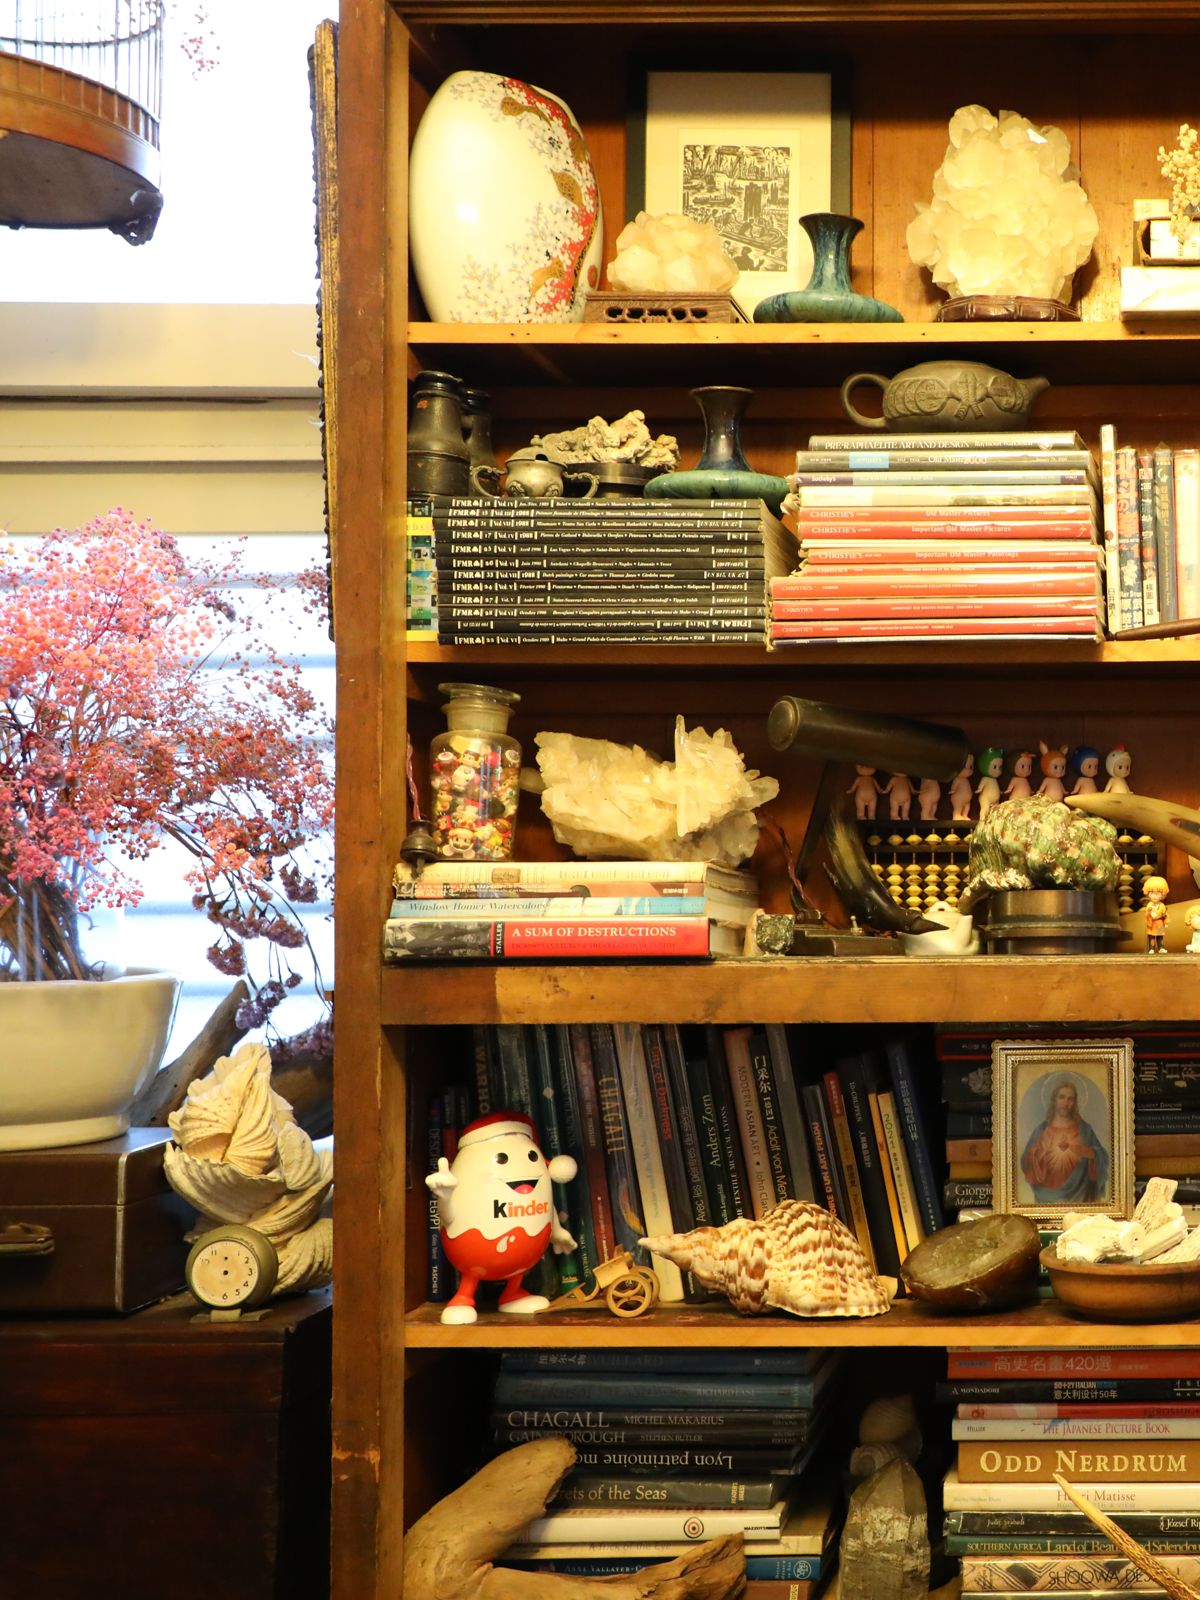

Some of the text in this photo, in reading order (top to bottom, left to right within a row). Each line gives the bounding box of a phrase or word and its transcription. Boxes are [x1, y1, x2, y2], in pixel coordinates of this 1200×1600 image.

[898, 440, 914, 450] ART
[915, 440, 936, 449] AND
[937, 440, 970, 448] DESIGN
[810, 510, 855, 518] CHRISTIE'S
[812, 524, 1011, 534] CHRISTIE'S Important Old Master Pictures
[916, 551, 948, 559] Important
[987, 550, 1018, 559] Paintings
[496, 923, 504, 955] STALLER
[512, 926, 676, 938] A SUM OF DESTRUCTIONS
[598, 1075, 625, 1156] CHAGALL
[658, 1087, 672, 1140] Darkness
[754, 1056, 784, 1170] 门采尔 Adolf von
[702, 1094, 721, 1168] Anders Zorn
[737, 1066, 765, 1192] MODERN ASIAN ART John
[884, 1114, 895, 1149] 2021
[724, 1136, 742, 1204] TEXTILE MUSEUM
[494, 1200, 549, 1218] kinder
[508, 1410, 724, 1428] CHAGALL MICHEL MAKARIUS
[1063, 1423, 1102, 1434] JAPANESE
[1106, 1423, 1142, 1434] PICTURE
[1146, 1422, 1170, 1433] BOOK
[604, 1452, 733, 1469] Lyon patrimoine
[980, 1450, 1187, 1473] ODD NERDRUM
[588, 1484, 667, 1500] of the Seas
[1094, 1490, 1136, 1502] Matisse
[968, 1540, 1074, 1552] SOUTHERN AFRICA Land
[1049, 1570, 1120, 1585] SHOOWA
